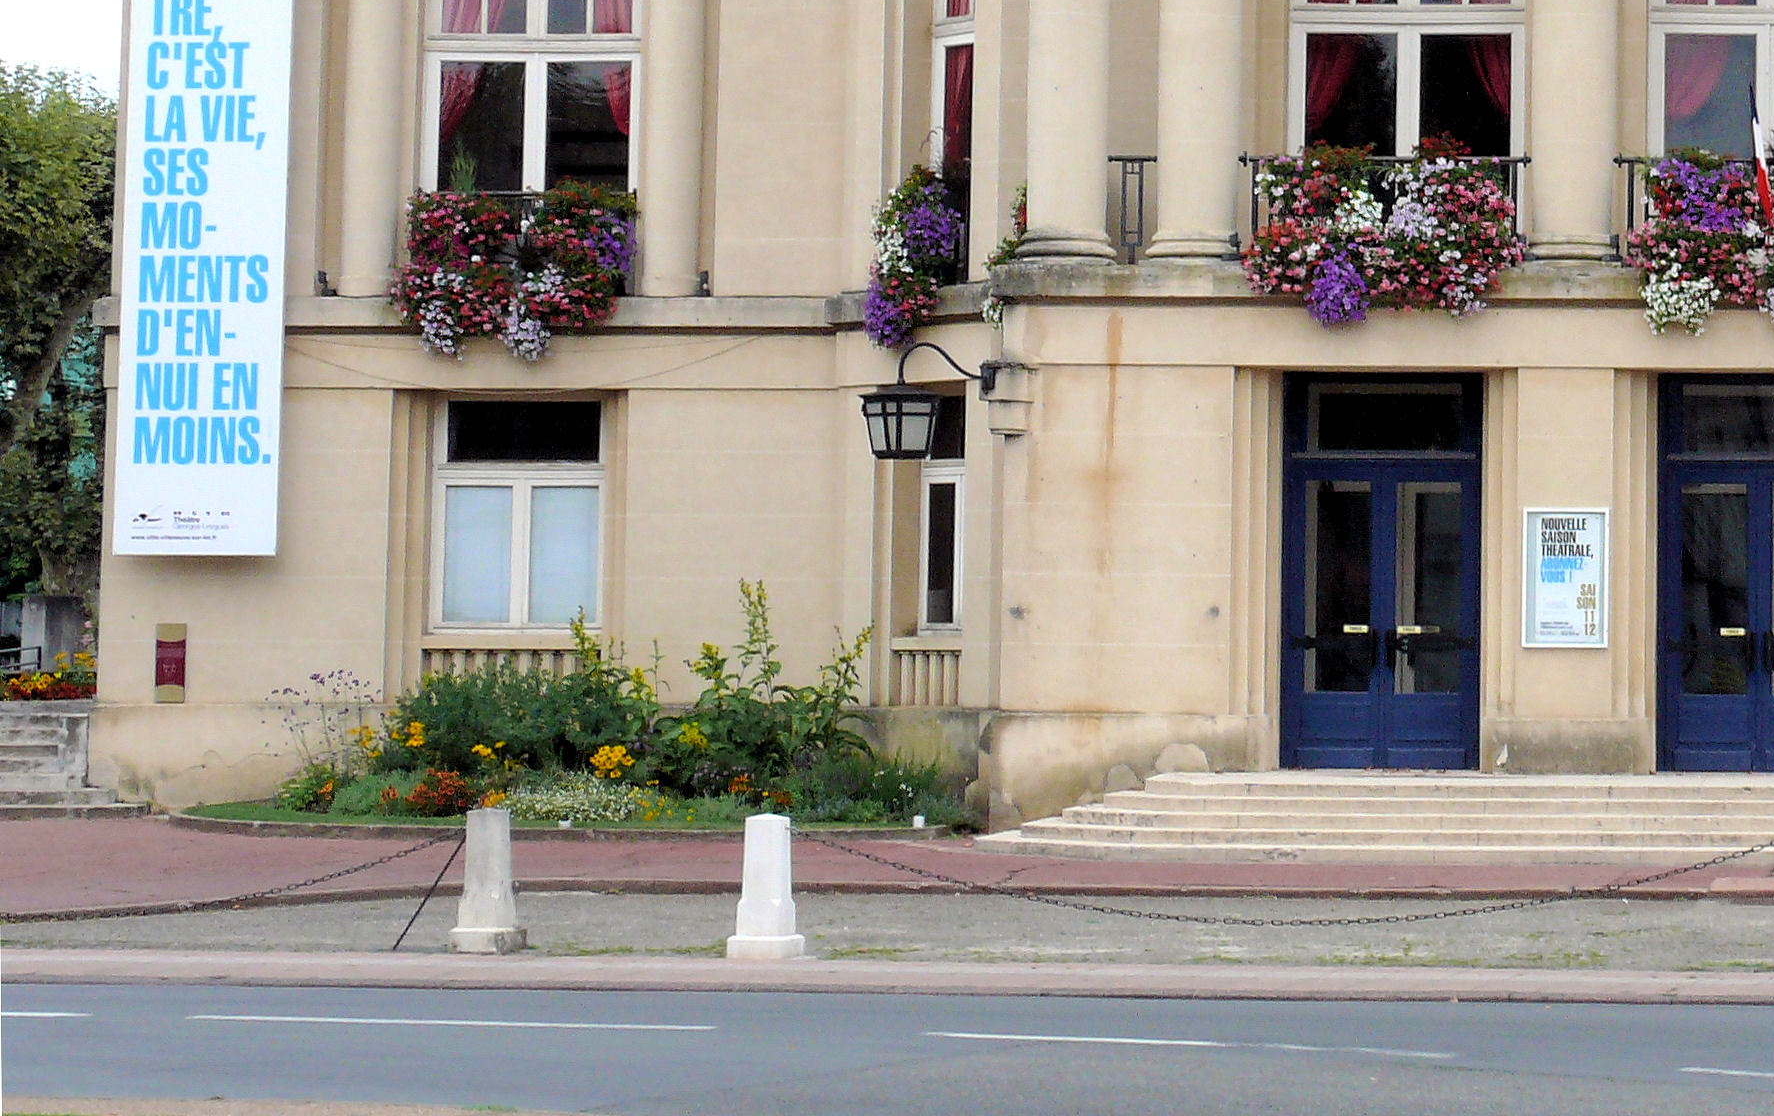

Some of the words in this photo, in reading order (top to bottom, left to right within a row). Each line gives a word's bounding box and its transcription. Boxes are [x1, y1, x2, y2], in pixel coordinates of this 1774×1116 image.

[146, 41, 250, 90] C'EST
[144, 95, 187, 143] LA
[200, 95, 266, 151] VIE,
[142, 147, 209, 197] SES
[139, 201, 217, 250] MO-
[138, 254, 269, 304] MENTS
[136, 308, 237, 357] D'EN-
[134, 362, 199, 411] NUI
[212, 362, 259, 411] EN
[132, 415, 271, 466] MOINS.
[1541, 517, 1587, 530] NOUVELLE
[1541, 531, 1576, 543] SAISON
[1541, 544, 1594, 559] THEATRALE,
[1541, 570, 1565, 582] VOUS
[1580, 583, 1596, 596] SAI
[1576, 596, 1596, 609] SON
[1584, 610, 1594, 622] 11
[1584, 623, 1597, 636] 12
